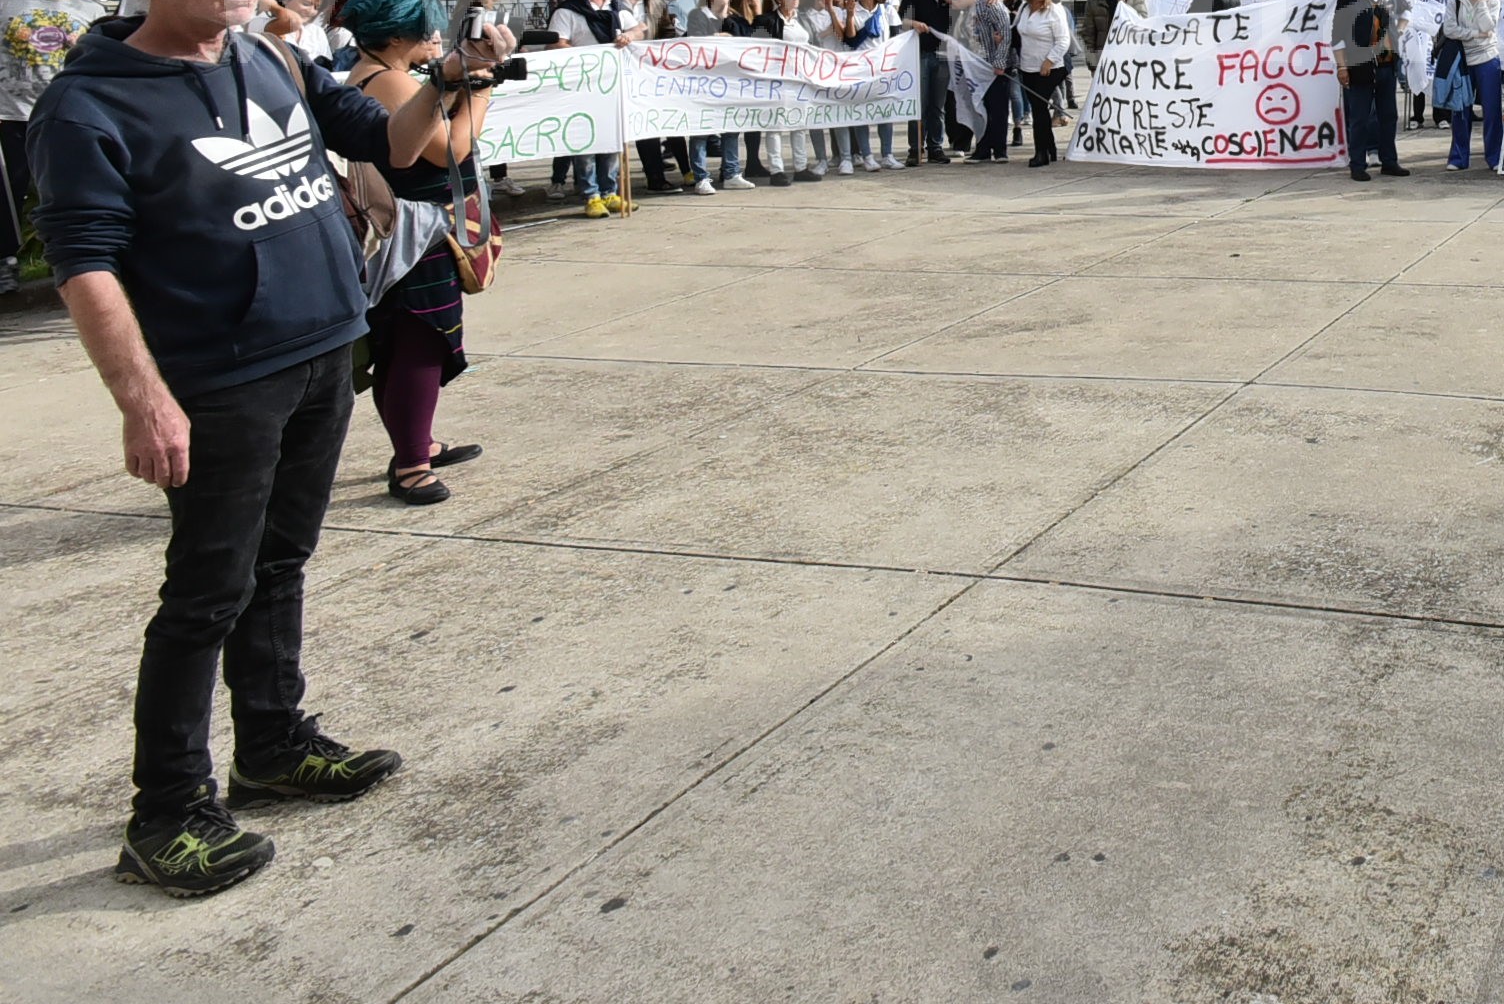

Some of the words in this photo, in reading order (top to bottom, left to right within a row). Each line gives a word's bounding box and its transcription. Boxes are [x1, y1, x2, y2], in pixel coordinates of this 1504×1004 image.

[1281, 3, 1327, 34] LE
[639, 41, 718, 71] NON
[737, 41, 898, 82] CHIUDETE
[1097, 57, 1193, 91] NOSTRE
[1216, 42, 1335, 87] FACCE
[738, 78, 784, 100] PER
[628, 108, 689, 136] FORZA
[699, 109, 715, 130] E
[722, 107, 803, 129] FUTURO
[805, 104, 833, 126] PER
[865, 98, 918, 121] RAGAZZI
[1090, 92, 1216, 131] POTRESTE
[478, 112, 596, 162] SACRO
[1075, 122, 1168, 159] PORTARLE
[232, 173, 335, 231] adidas
